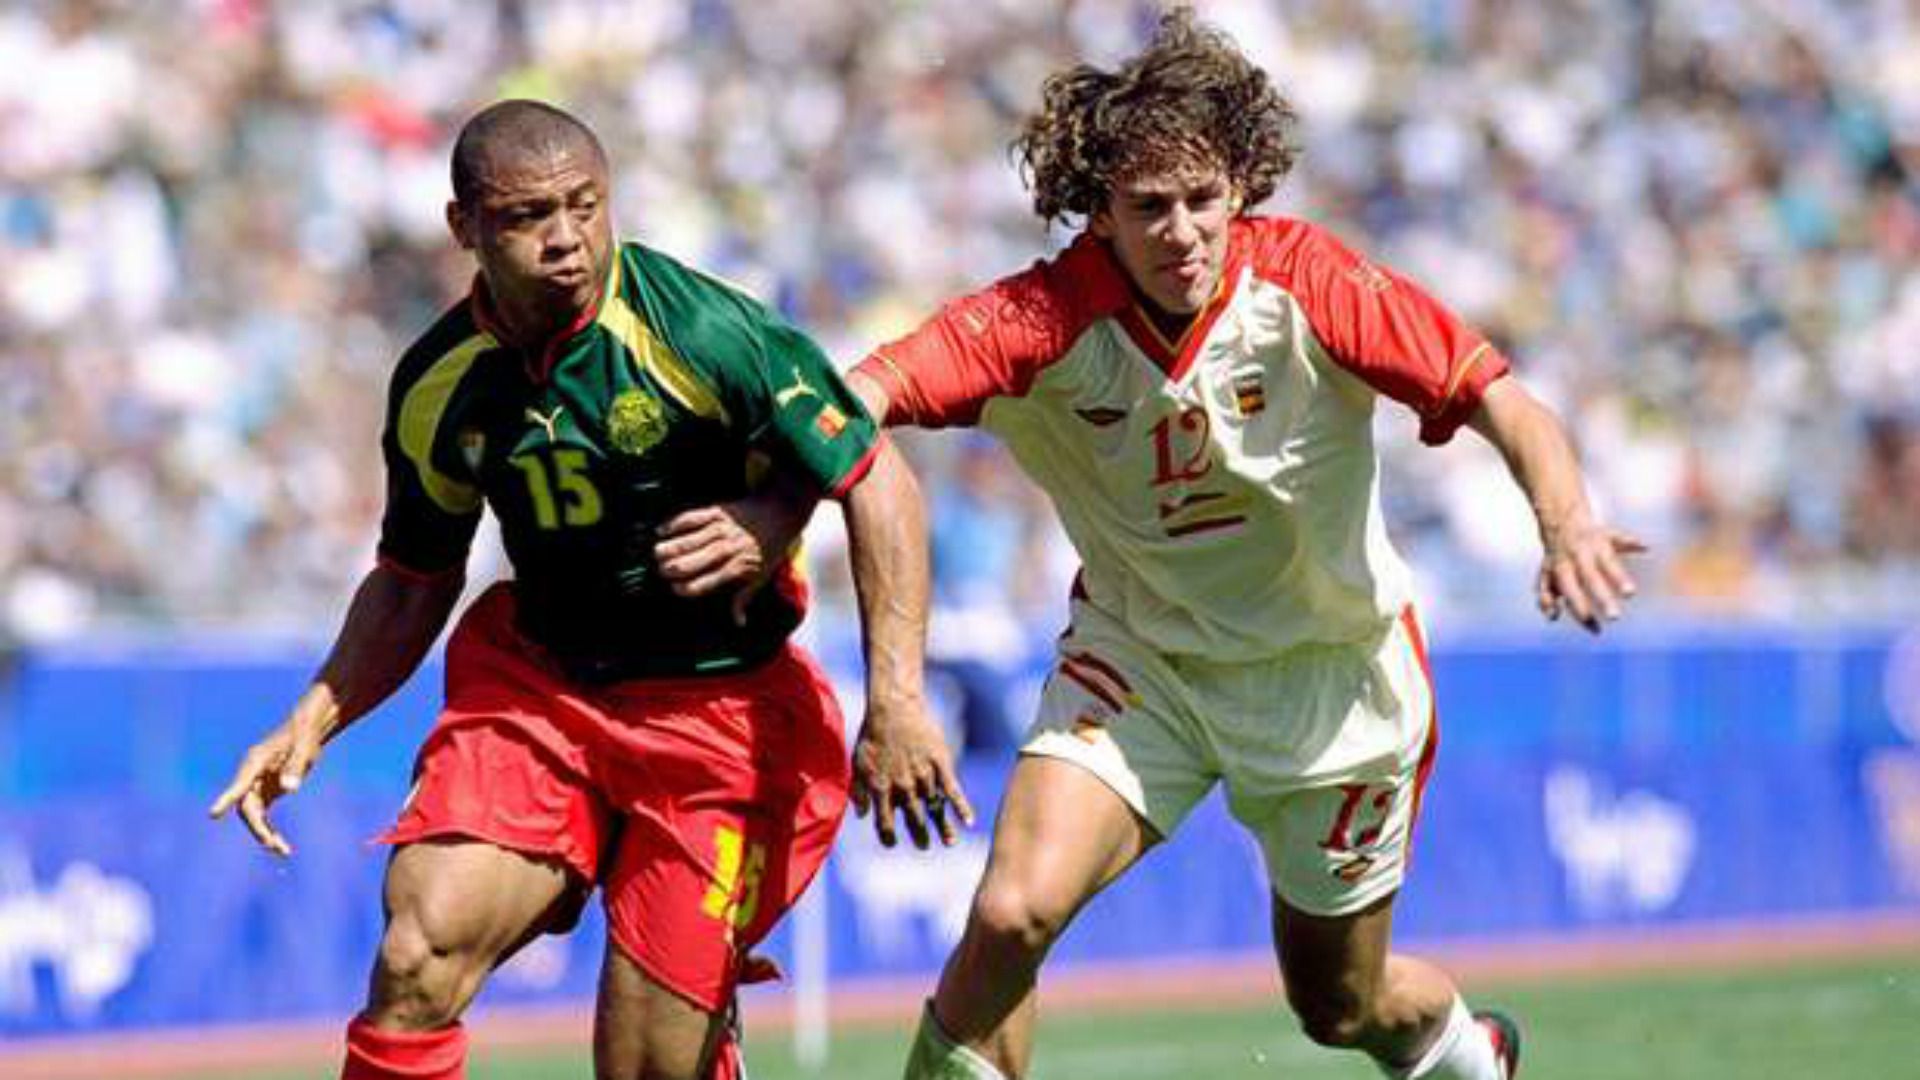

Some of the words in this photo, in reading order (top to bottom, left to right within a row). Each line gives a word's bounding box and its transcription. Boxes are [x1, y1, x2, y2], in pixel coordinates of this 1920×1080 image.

[1148, 406, 1212, 487] 12
[514, 450, 604, 530] 15
[700, 825, 766, 928] 15
